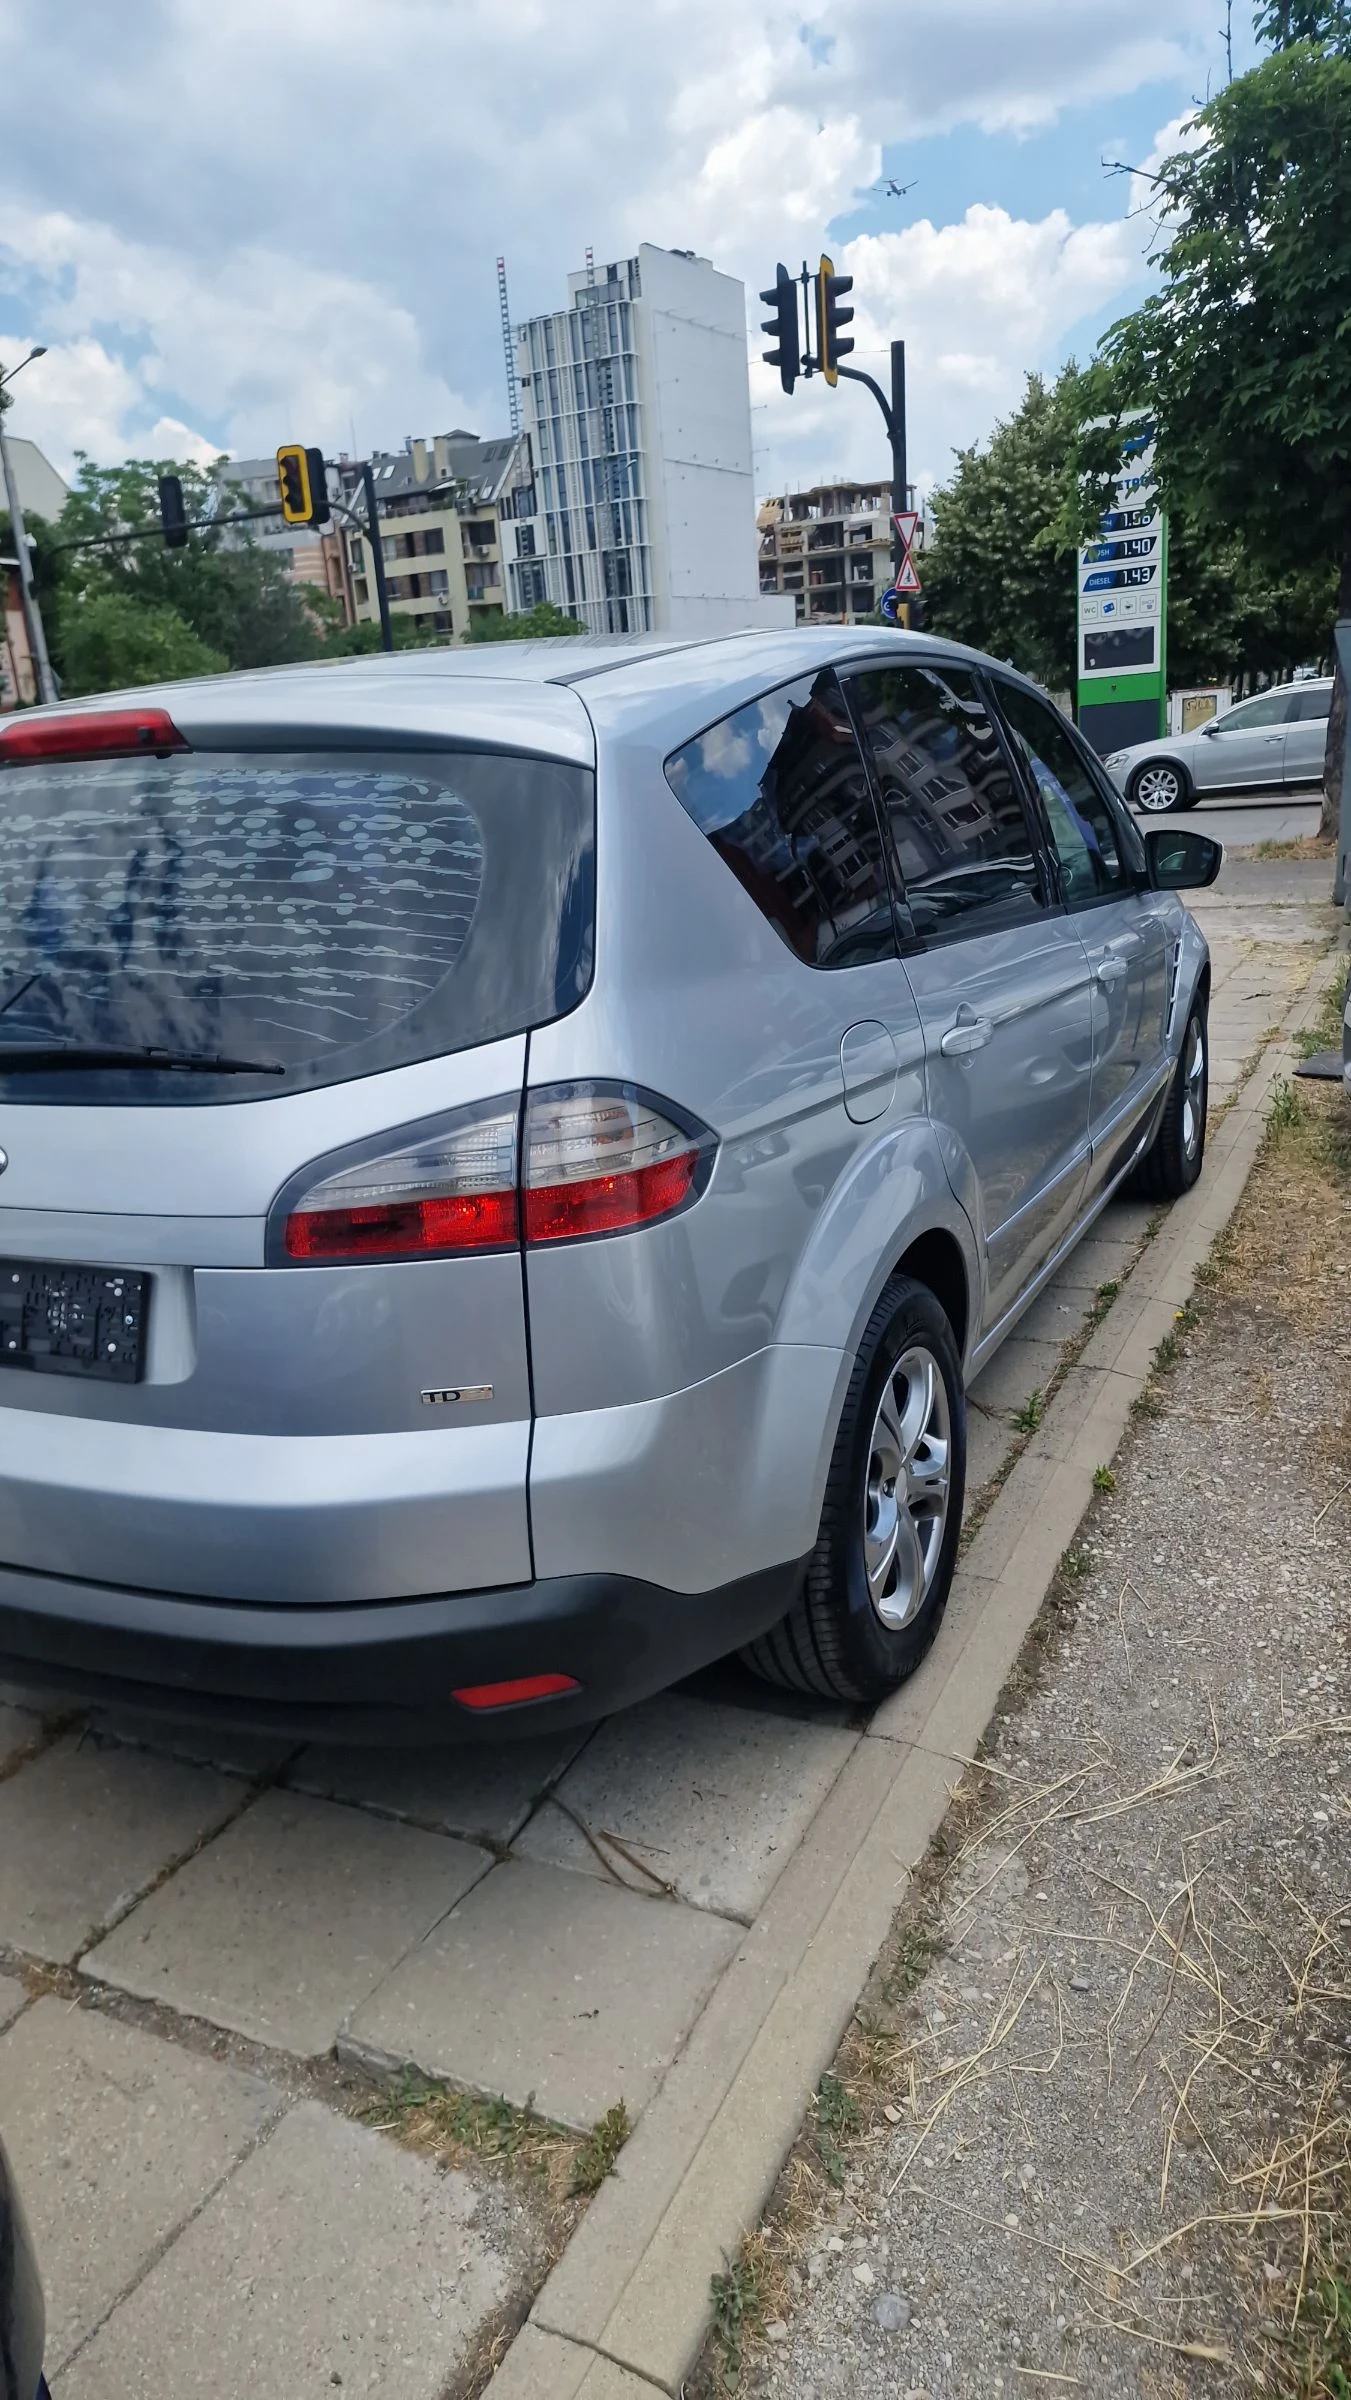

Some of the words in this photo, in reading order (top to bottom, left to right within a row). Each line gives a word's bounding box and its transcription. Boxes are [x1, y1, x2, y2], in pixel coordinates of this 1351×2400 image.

[1123, 538, 1151, 555] 1.40
[1089, 577, 1111, 586] DIESEL
[1123, 567, 1151, 584] 1.43
